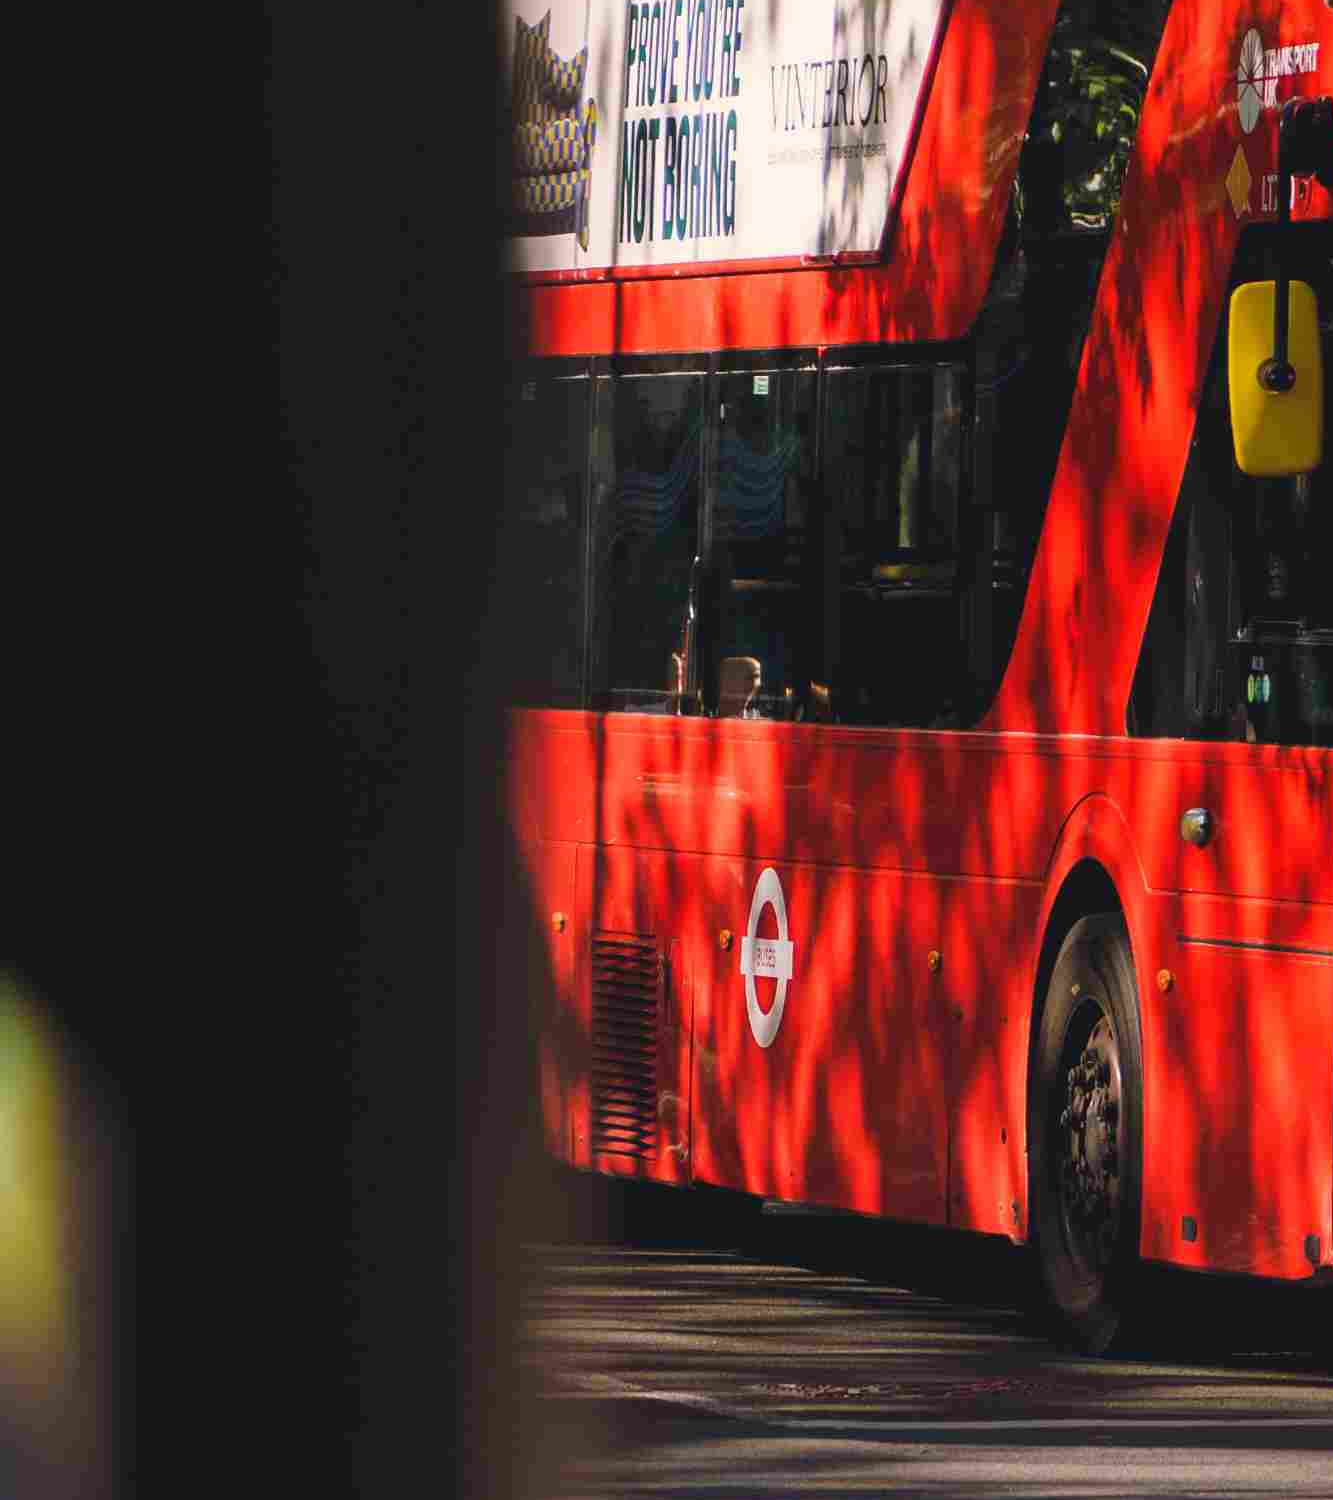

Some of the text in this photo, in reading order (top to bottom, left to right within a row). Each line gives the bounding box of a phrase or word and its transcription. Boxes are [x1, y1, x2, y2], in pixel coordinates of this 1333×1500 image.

[624, 0, 683, 108] PROVE
[768, 52, 888, 132] VINTERIOR
[1264, 43, 1319, 78] TRANSPORT
[1264, 79, 1278, 108] UK
[619, 109, 738, 244] NOT BORING
